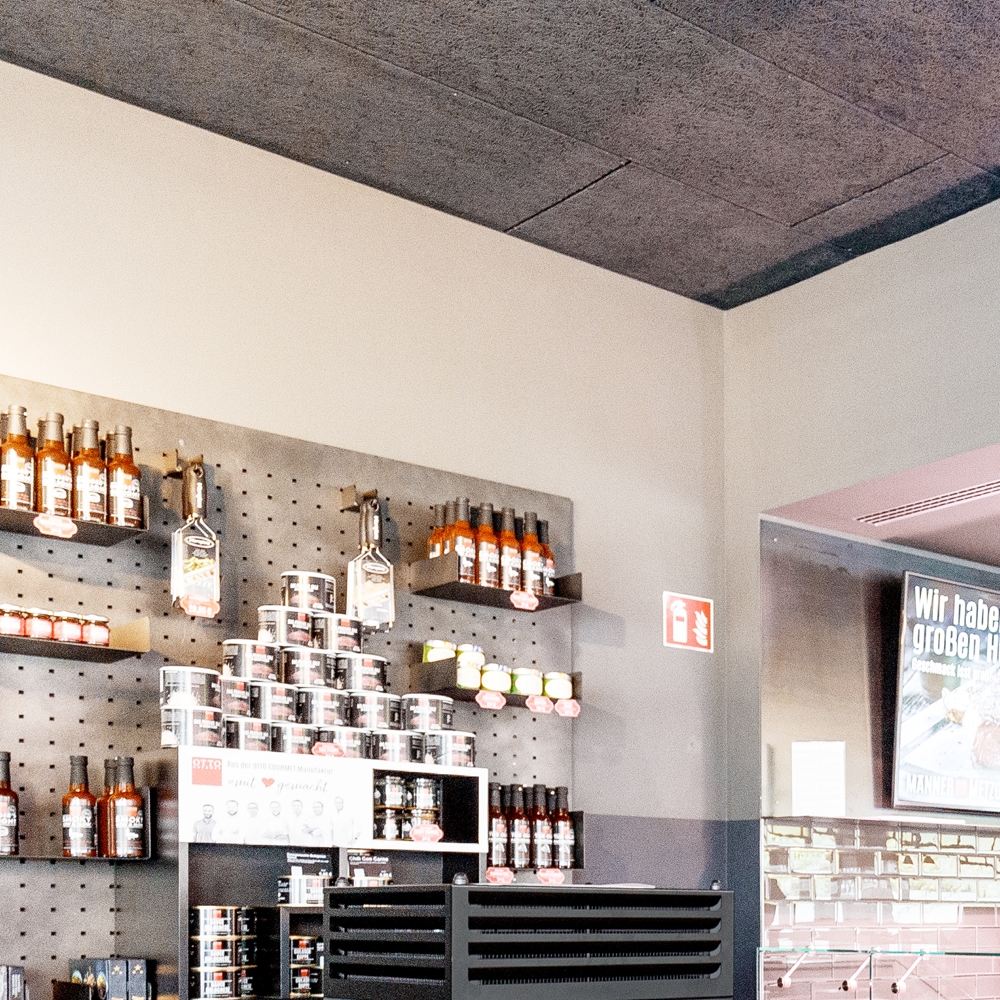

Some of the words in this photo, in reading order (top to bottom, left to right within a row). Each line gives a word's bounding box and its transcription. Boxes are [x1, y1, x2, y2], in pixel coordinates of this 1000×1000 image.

[914, 586, 948, 622] Wir
[913, 623, 980, 660] großen
[192, 759, 222, 767] OTTO
[227, 760, 239, 769] Aus
[277, 781, 329, 795] gemacht
[906, 773, 954, 797] MÄNNER
